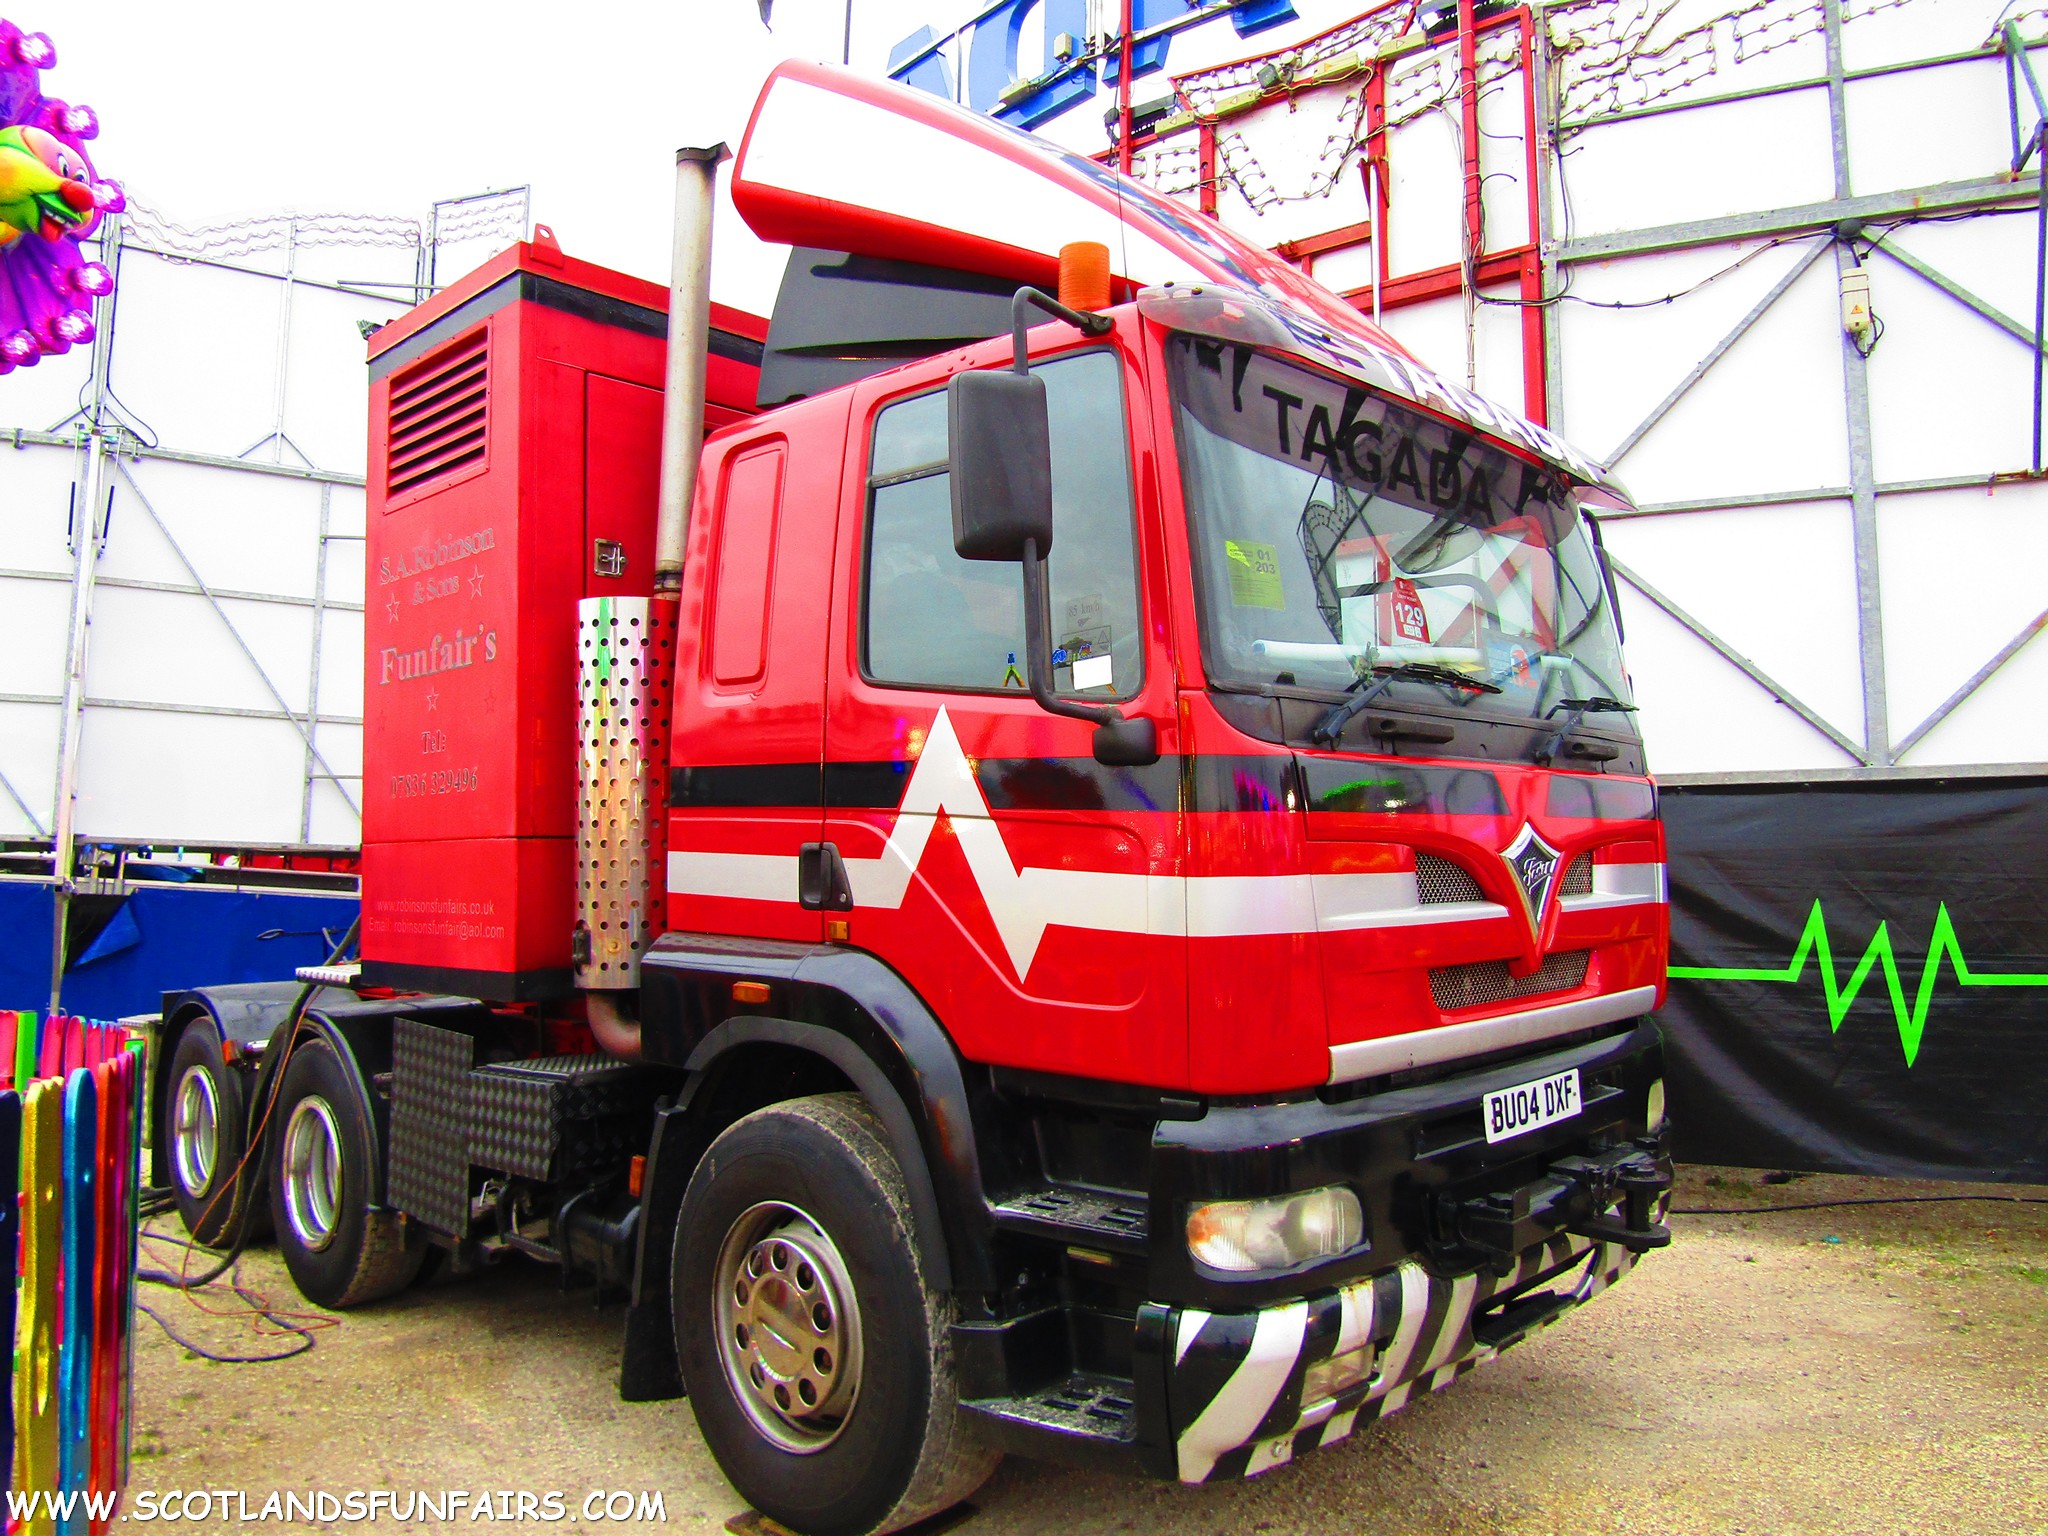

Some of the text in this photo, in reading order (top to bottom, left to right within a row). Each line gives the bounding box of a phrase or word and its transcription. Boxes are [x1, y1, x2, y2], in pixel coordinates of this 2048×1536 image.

[1262, 384, 1497, 527] TAGADA
[412, 575, 461, 606] & Sons
[1395, 602, 1425, 627] 129
[379, 622, 498, 686] Funfair's
[421, 729, 448, 755] Tel:
[391, 766, 479, 799] 07836 329496
[376, 897, 496, 915] www.robinsonsfunfairs.co.uk
[393, 918, 506, 941] robinsonsfunfair@aol.com
[1491, 1073, 1576, 1135] BU04 DXF
